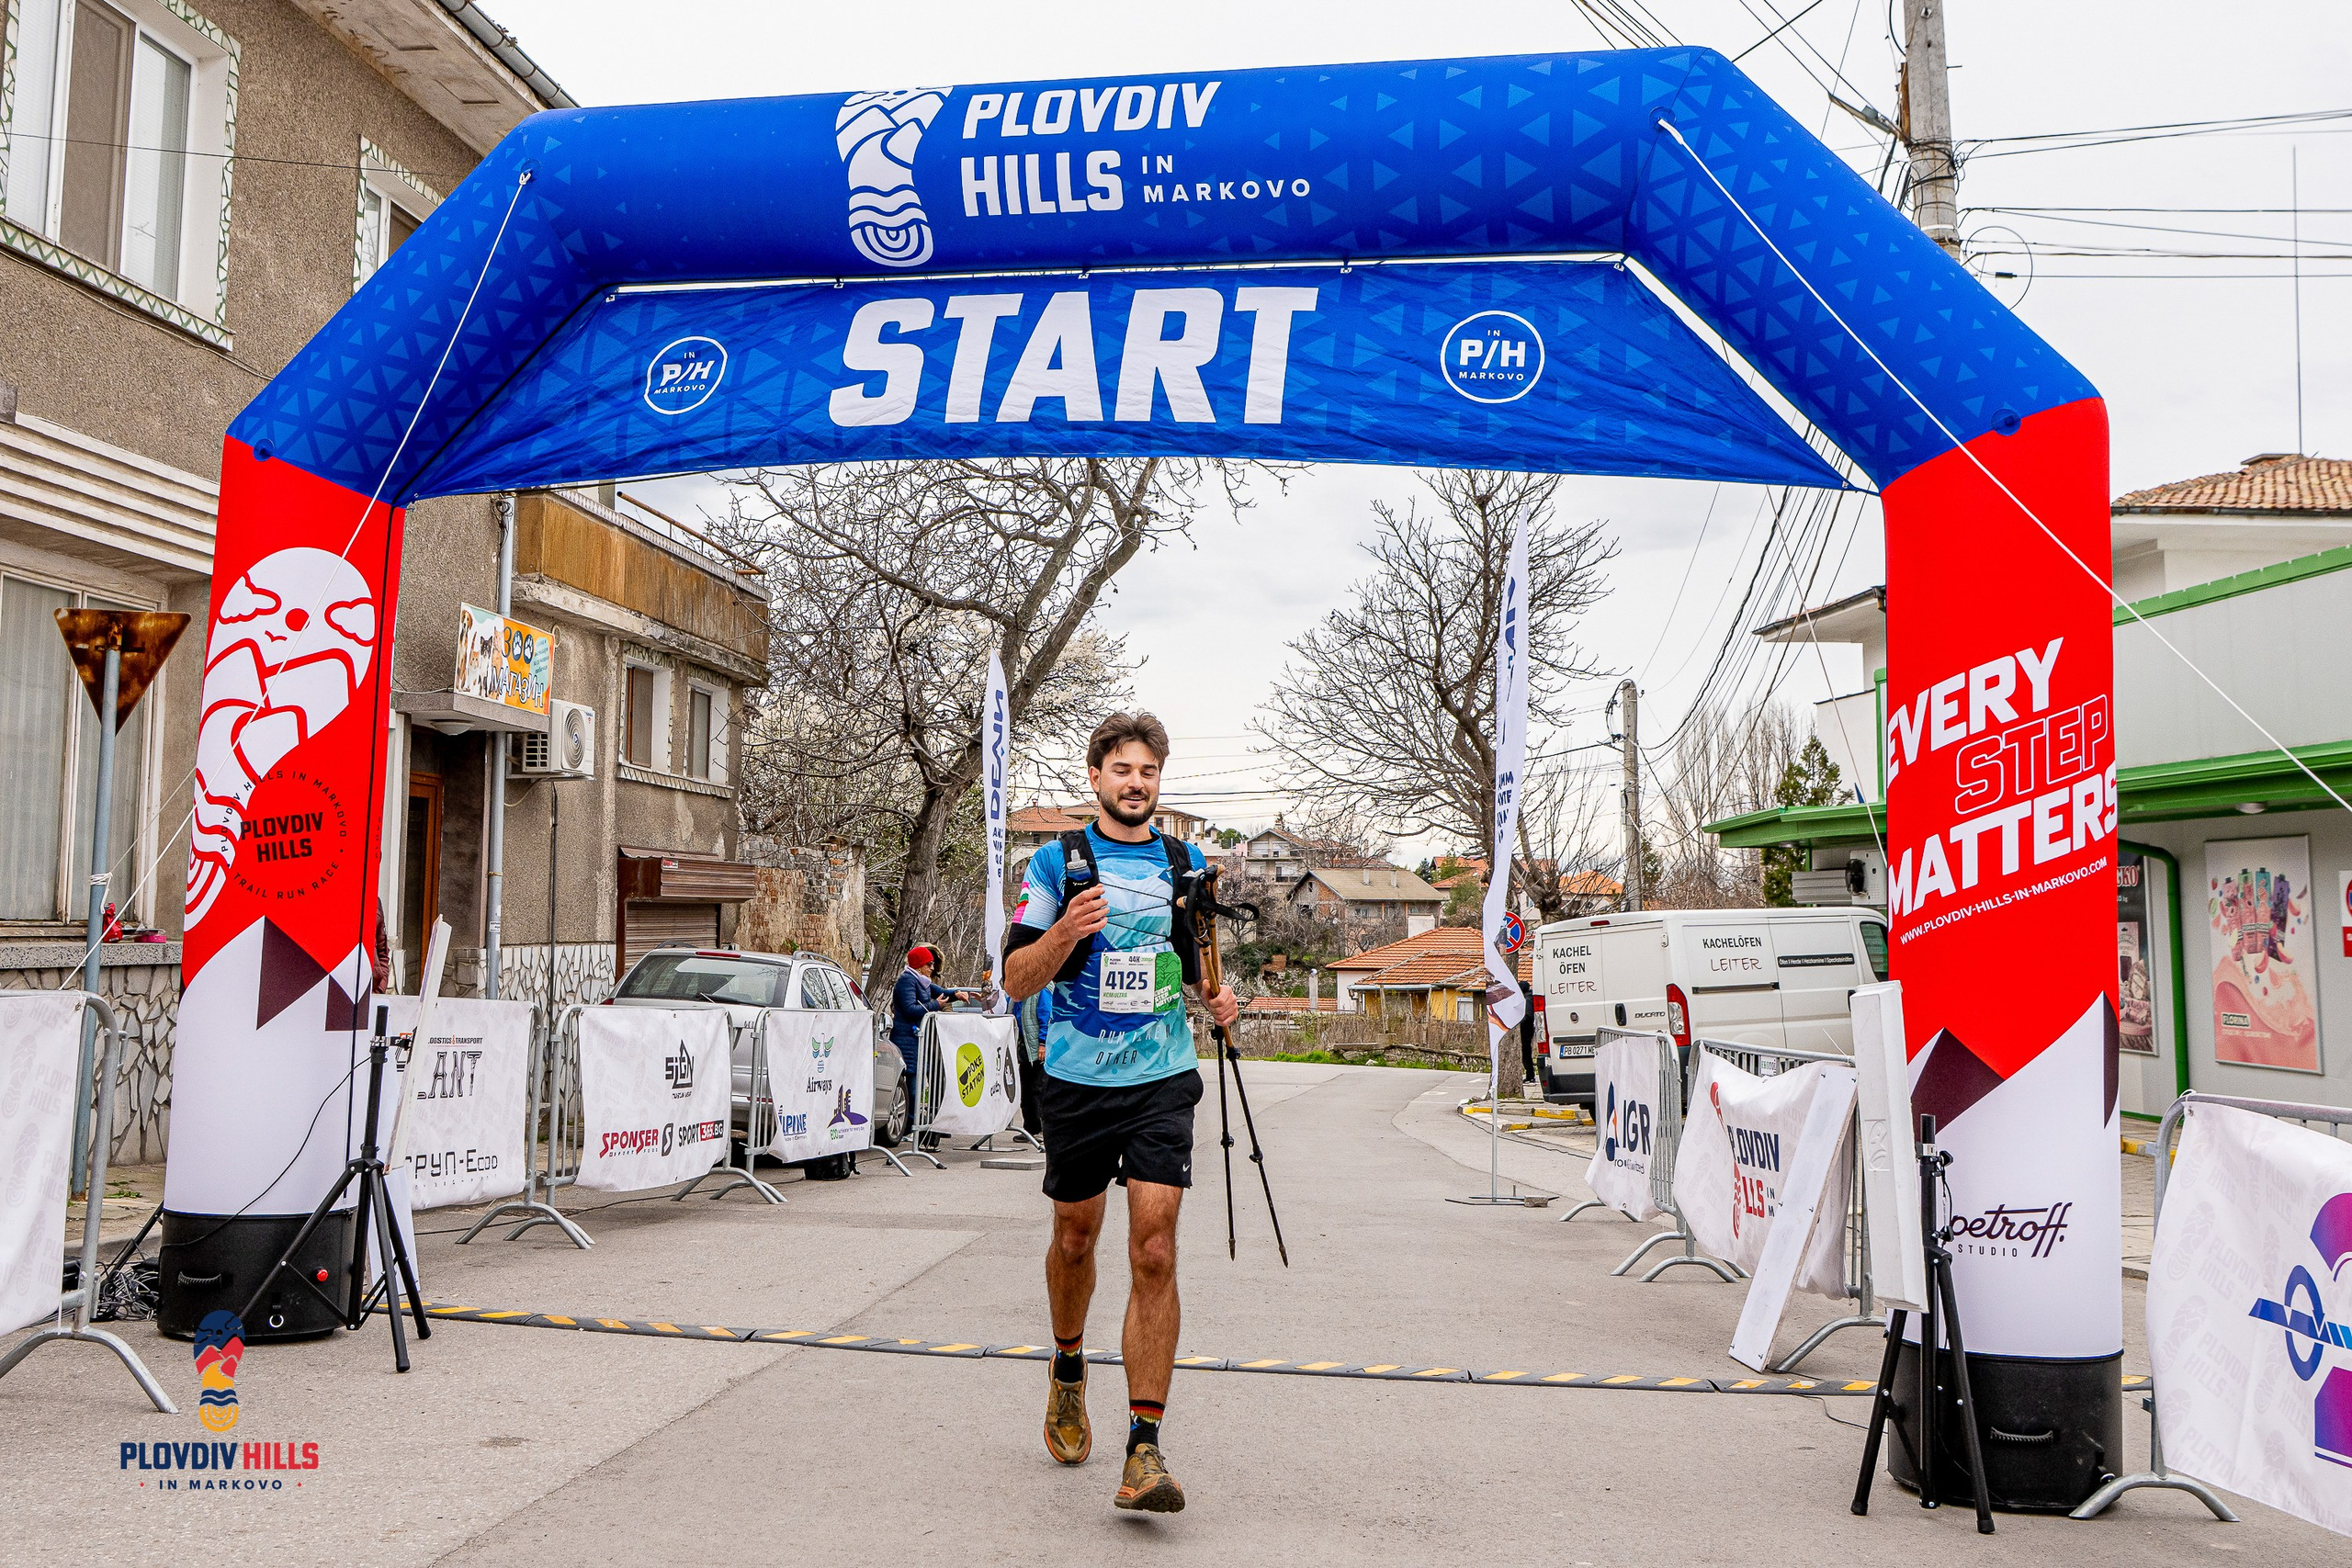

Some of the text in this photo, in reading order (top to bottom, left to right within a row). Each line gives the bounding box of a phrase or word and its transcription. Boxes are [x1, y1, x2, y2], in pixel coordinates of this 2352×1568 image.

[962, 81, 1222, 140] PLOVDIV
[960, 150, 1174, 218] HILLS IN
[1143, 177, 1312, 204] MARKOVO
[1487, 329, 1501, 337] IN
[684, 351, 695, 359] IN
[829, 286, 1320, 428] START
[1459, 339, 1527, 369] P/H
[660, 359, 716, 387] P/H
[1458, 371, 1526, 382] MARKOVO
[653, 383, 707, 395] MARKOVO
[490, 665, 545, 708] МАГАЗИН
[1886, 637, 2064, 789] EVERY
[1955, 694, 2109, 816] STEP
[220, 792, 242, 852] PLOVDIV
[243, 770, 284, 792] HILLS
[292, 771, 307, 781] IN
[312, 778, 347, 838] MARKOVO
[240, 811, 323, 841] PLOVDIV
[256, 838, 312, 863] HILLS
[1887, 759, 2119, 933] MATTERS
[232, 861, 339, 899] TRAIL RUN RACE
[1900, 855, 2109, 945] WWW.PLOVDIV-HILLS-IN-MARKOVO.COM
[1553, 944, 1592, 959] KACHEL
[1702, 934, 1762, 950] KACHELÖFEN
[1128, 955, 1141, 964] 44K
[1559, 960, 1587, 976] ÖFEN
[1710, 956, 1763, 973] LEITER
[1105, 970, 1148, 990] 4125
[1549, 979, 1598, 996] LEITER
[1098, 1028, 1126, 1045] RUN
[967, 1055, 983, 1077] POKE
[1095, 1049, 1138, 1066] OTHER
[806, 1077, 832, 1095] Airways
[961, 1066, 985, 1100] STATION
[1623, 1099, 1651, 1156] IGR
[599, 1128, 659, 1159] SPONSER
[1725, 1123, 1781, 1173] POVDIV
[1741, 1176, 1766, 1219] LLS
[1766, 1186, 1776, 1200] IN
[1957, 1243, 2018, 1258] STUDIO
